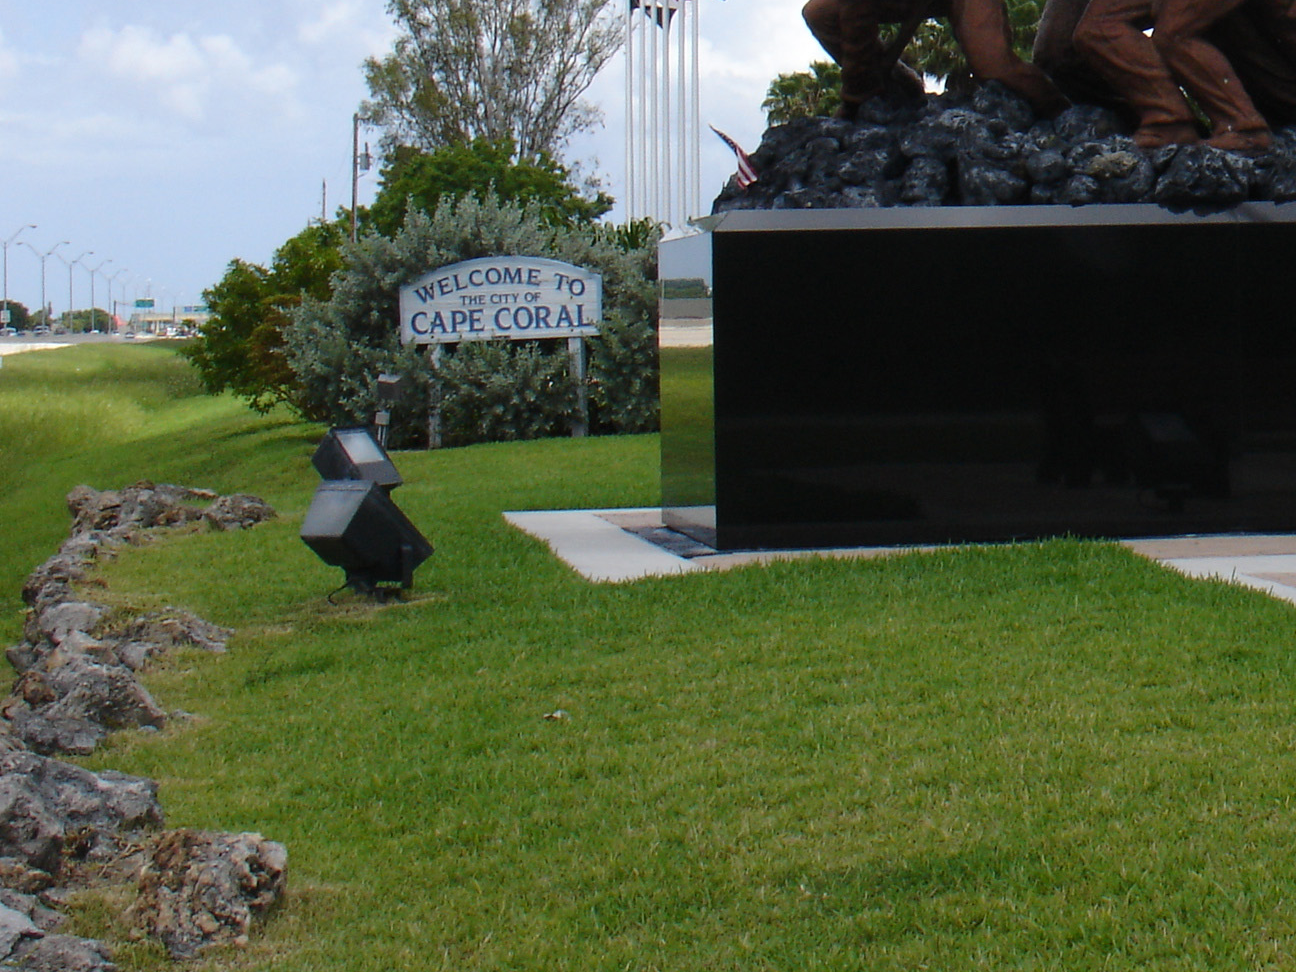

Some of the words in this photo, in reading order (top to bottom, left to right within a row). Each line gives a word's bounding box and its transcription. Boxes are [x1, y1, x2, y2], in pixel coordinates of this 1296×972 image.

[413, 267, 542, 304] WELCOME
[554, 272, 586, 297] TO
[460, 295, 486, 306] THE
[490, 292, 519, 305] CITY
[524, 291, 542, 303] OF
[411, 307, 485, 335] CAPE
[494, 304, 594, 331] CORAL
